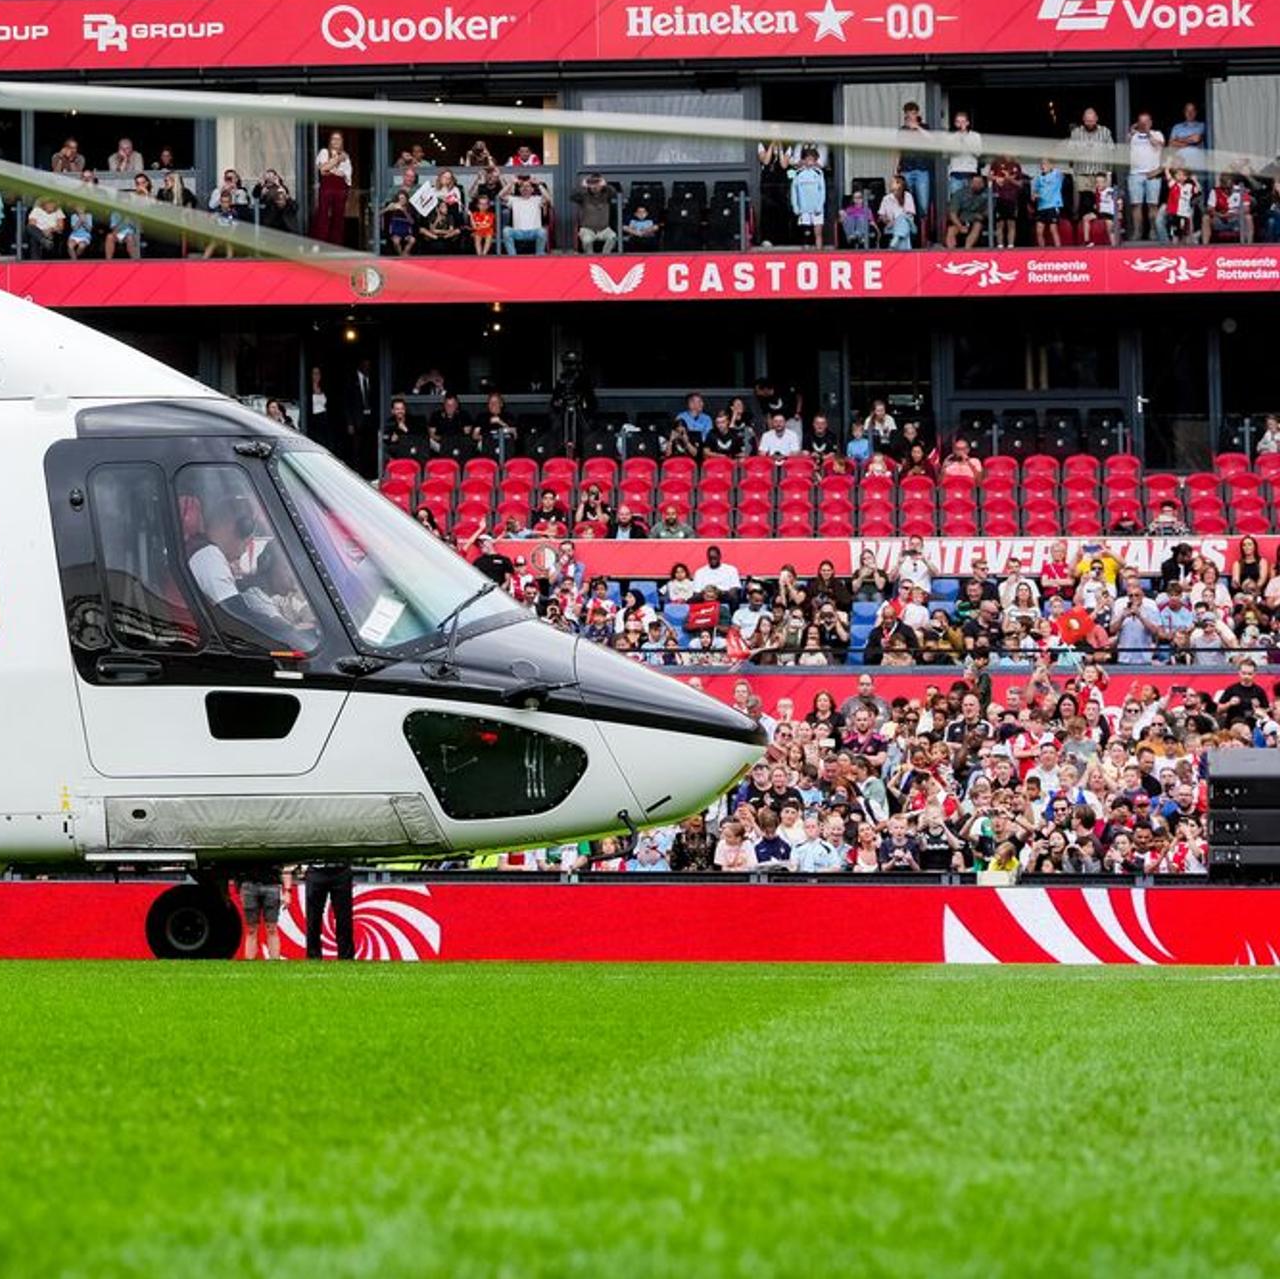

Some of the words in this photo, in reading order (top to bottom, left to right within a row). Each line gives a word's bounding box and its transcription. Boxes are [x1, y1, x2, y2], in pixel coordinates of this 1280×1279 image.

[321, 4, 508, 52] Quooker
[625, 4, 799, 37] Heineken
[886, 3, 935, 40] 0.0
[131, 23, 224, 39] GROUP
[1027, 260, 1087, 271] Gemeente
[1216, 257, 1277, 268] Gemeente
[667, 260, 883, 293] CASTORE
[1028, 271, 1090, 283] Rotterdam
[1216, 269, 1279, 280] Rotterdam
[1108, 538, 1228, 575] TAKS
